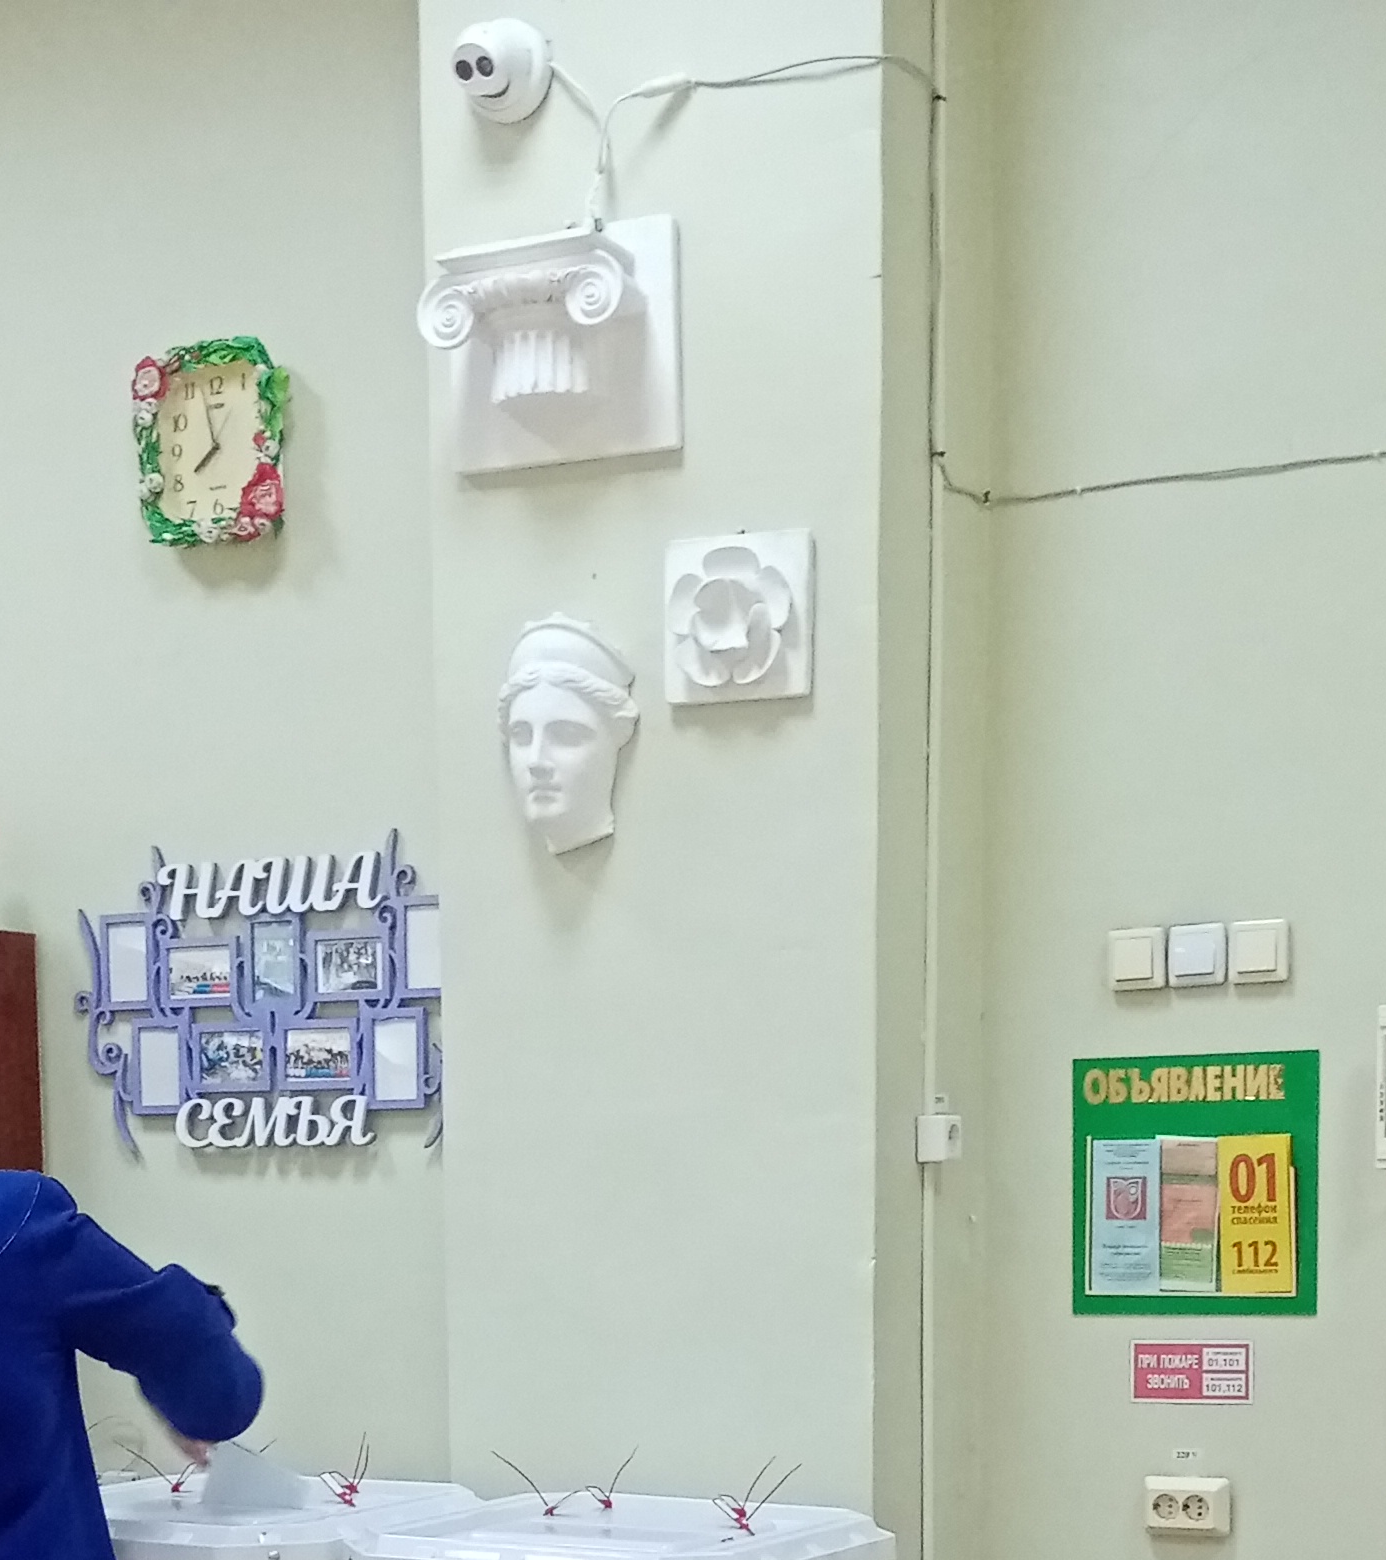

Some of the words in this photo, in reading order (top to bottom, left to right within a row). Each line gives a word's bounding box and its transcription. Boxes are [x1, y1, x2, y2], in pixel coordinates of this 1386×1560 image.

[209, 376, 223, 395] 12
[173, 413, 188, 433] 10
[171, 444, 183, 461] 9
[173, 474, 184, 492] 8
[186, 500, 197, 518] 7
[213, 499, 224, 515] 6
[157, 851, 382, 920] НАША
[1083, 1063, 1285, 1105] ОБЪЯВЛЕНИЕ
[175, 1095, 376, 1149] СЕМЬЯ
[1229, 1153, 1277, 1203] 01
[1230, 1203, 1278, 1216] телефон
[1231, 1216, 1279, 1225] спасения
[1231, 1240, 1279, 1268] 112
[1138, 1354, 1157, 1369] ПРИ
[1160, 1354, 1199, 1369] ПОЖАРЕ
[1146, 1374, 1190, 1389] ЗВОНИТЬ
